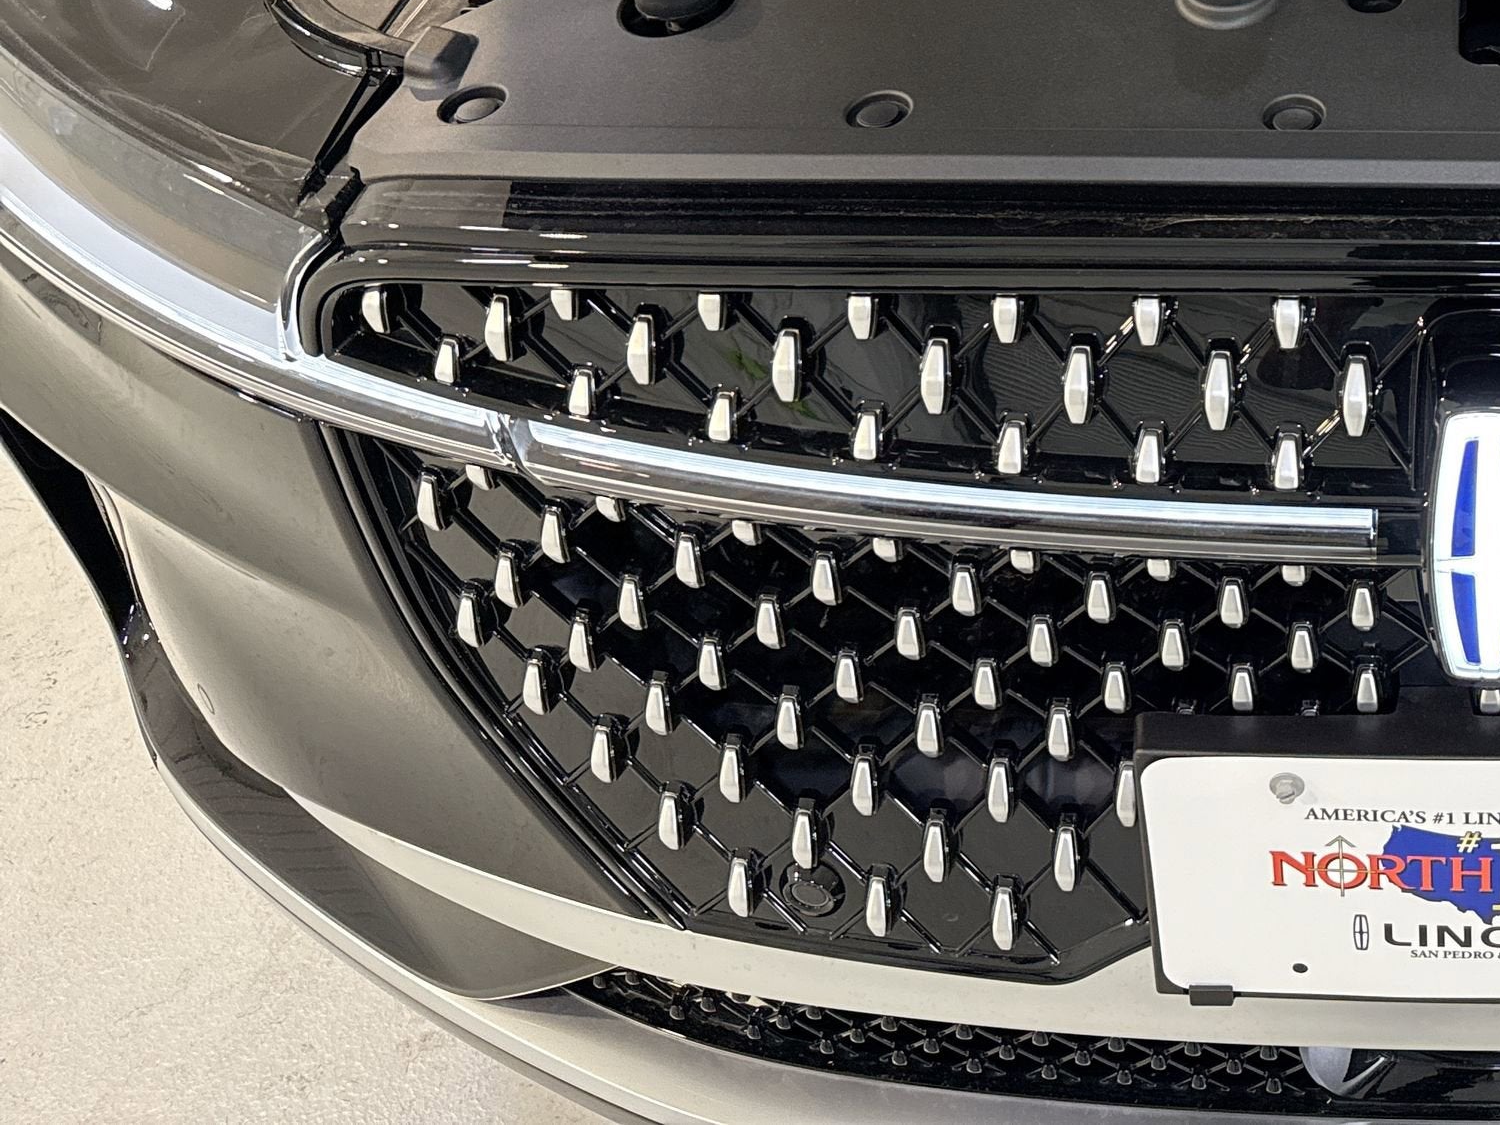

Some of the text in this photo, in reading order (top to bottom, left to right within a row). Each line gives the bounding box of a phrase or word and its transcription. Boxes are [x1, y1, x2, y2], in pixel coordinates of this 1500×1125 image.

[1304, 807, 1427, 824] AMERICA'S
[1432, 811, 1454, 825] #1
[1269, 850, 1495, 893] NORTH
[1410, 949, 1439, 959] SAN
[1443, 950, 1495, 960] PEDRO
